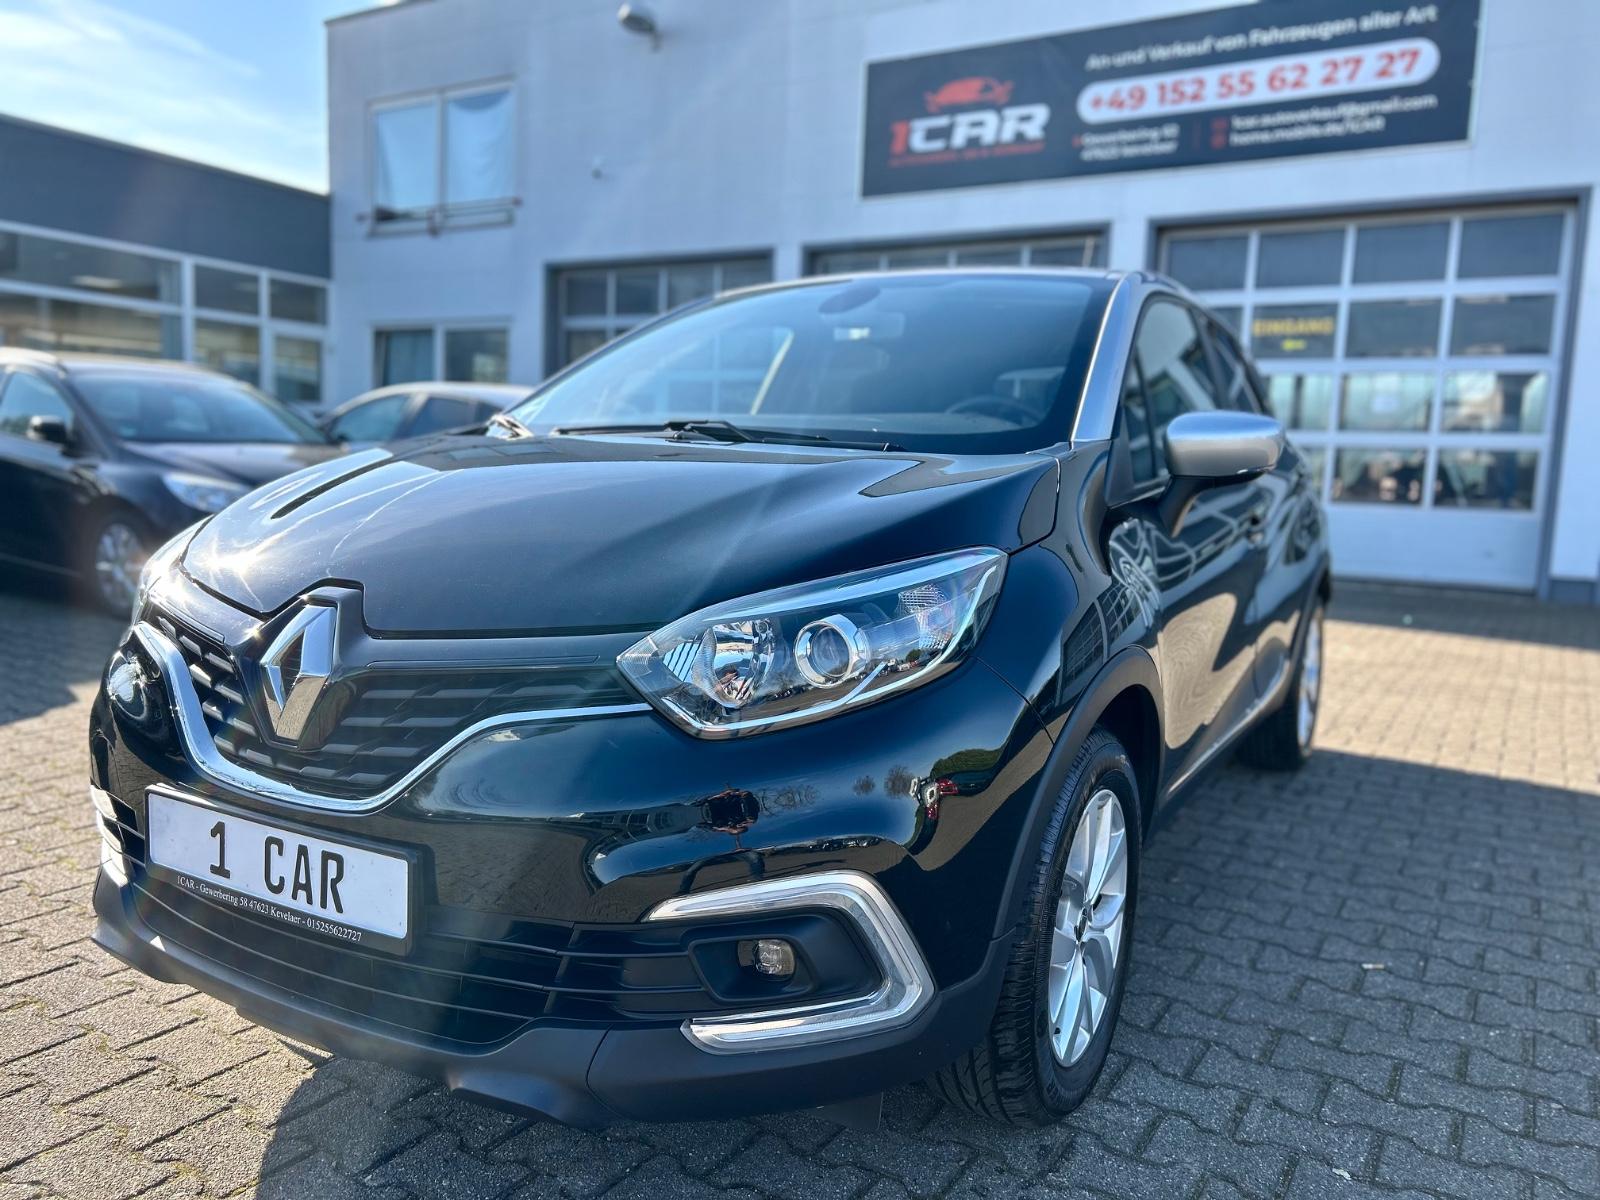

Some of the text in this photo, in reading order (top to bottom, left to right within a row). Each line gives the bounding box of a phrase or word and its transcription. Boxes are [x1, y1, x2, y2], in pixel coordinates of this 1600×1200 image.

[1150, 35, 1214, 61] Verkauf
[1214, 33, 1248, 52] von
[1249, 18, 1357, 47] Fahrzeugen
[1358, 11, 1401, 32] aller
[1403, 5, 1438, 26] Art
[1090, 48, 1421, 112] +49 152 55 62 27 27
[210, 821, 344, 914] 1 CAR
[199, 883, 239, 907] Gewerbering
[239, 896, 248, 907] 58
[248, 900, 269, 914] 47623
[270, 906, 301, 925] Kevelaer
